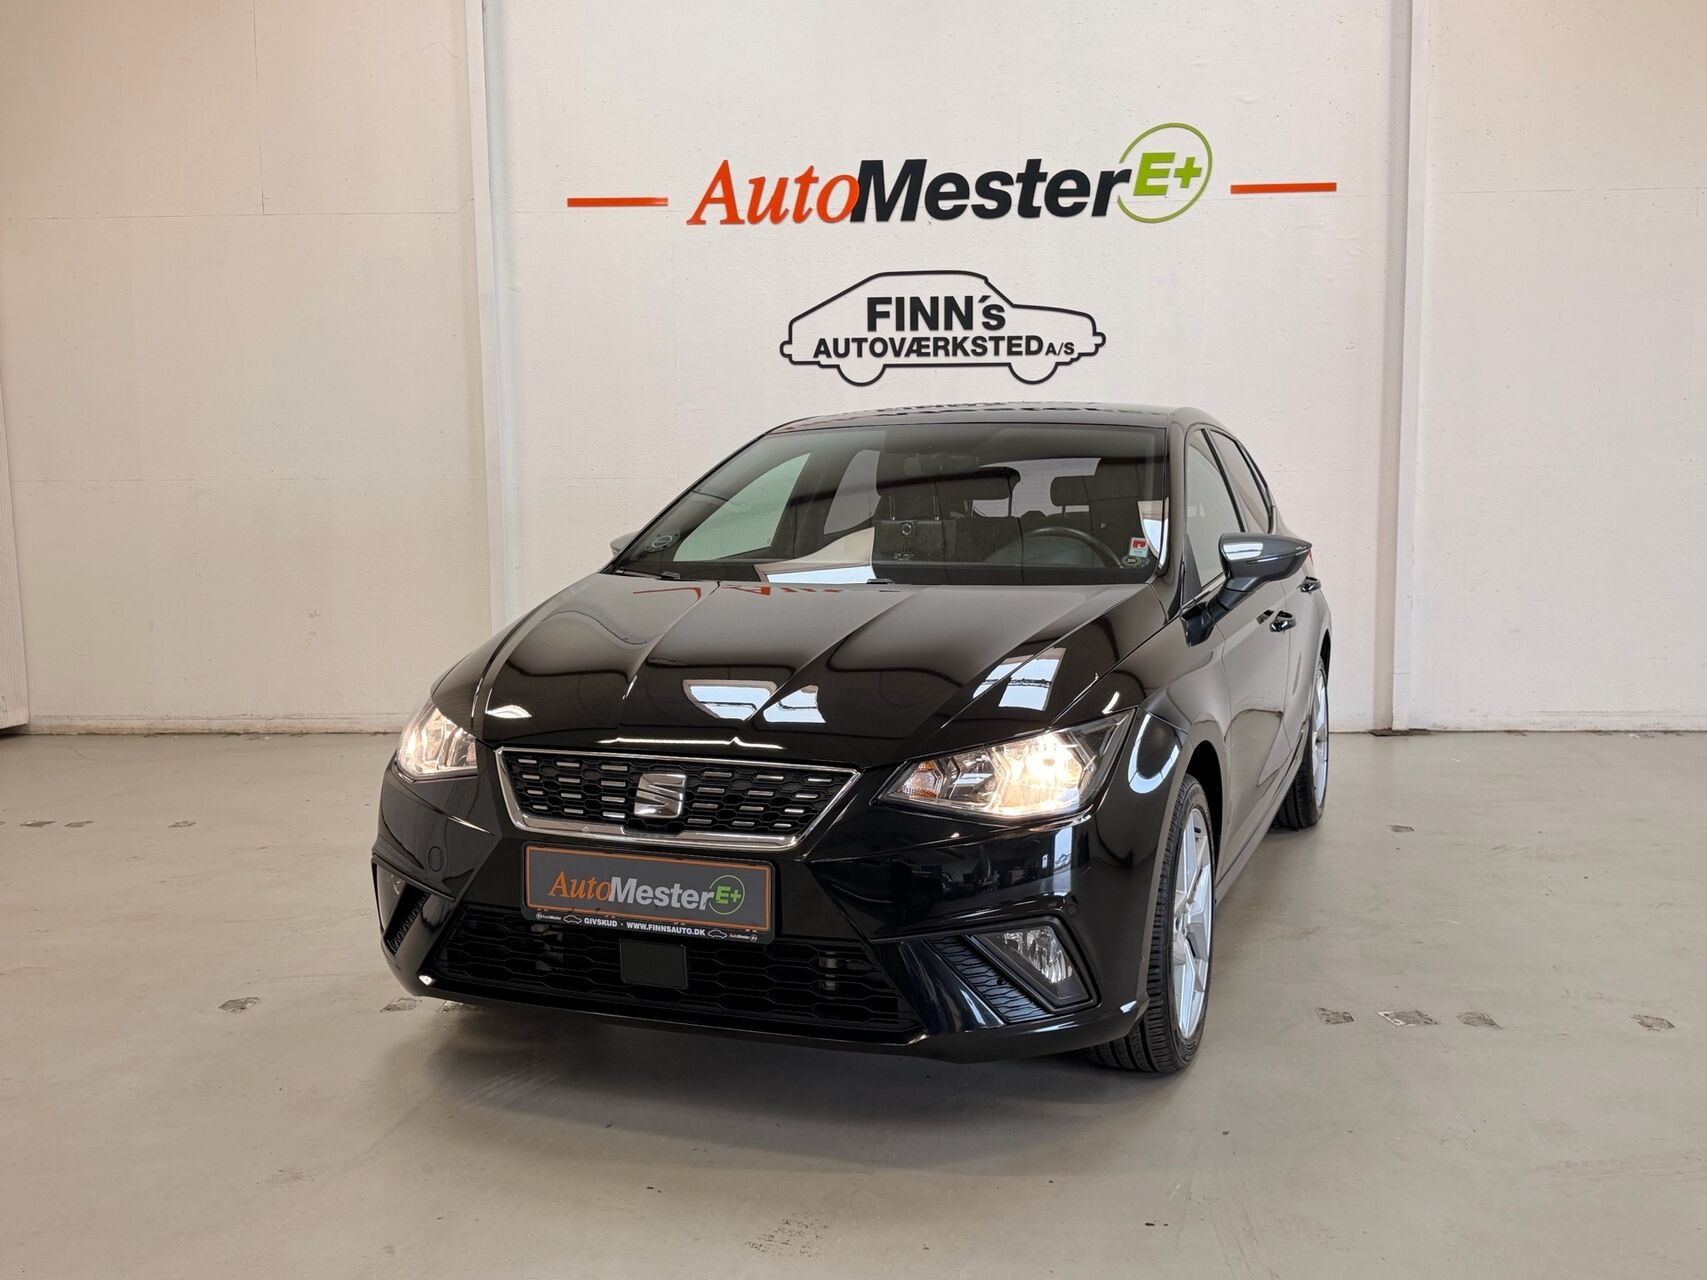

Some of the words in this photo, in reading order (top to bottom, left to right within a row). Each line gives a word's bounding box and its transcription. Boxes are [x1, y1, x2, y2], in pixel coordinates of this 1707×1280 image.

[686, 158, 1132, 225] AutoMester
[1133, 152, 1202, 196] E+
[813, 336, 1044, 358] AUTOVÆRKSTED
[1045, 342, 1075, 356] A/S
[548, 871, 714, 910] AutoMester
[715, 885, 742, 905] E+
[584, 917, 617, 927] GIVSKUD
[626, 921, 706, 936] WWW.FINNSAUTO.DK
